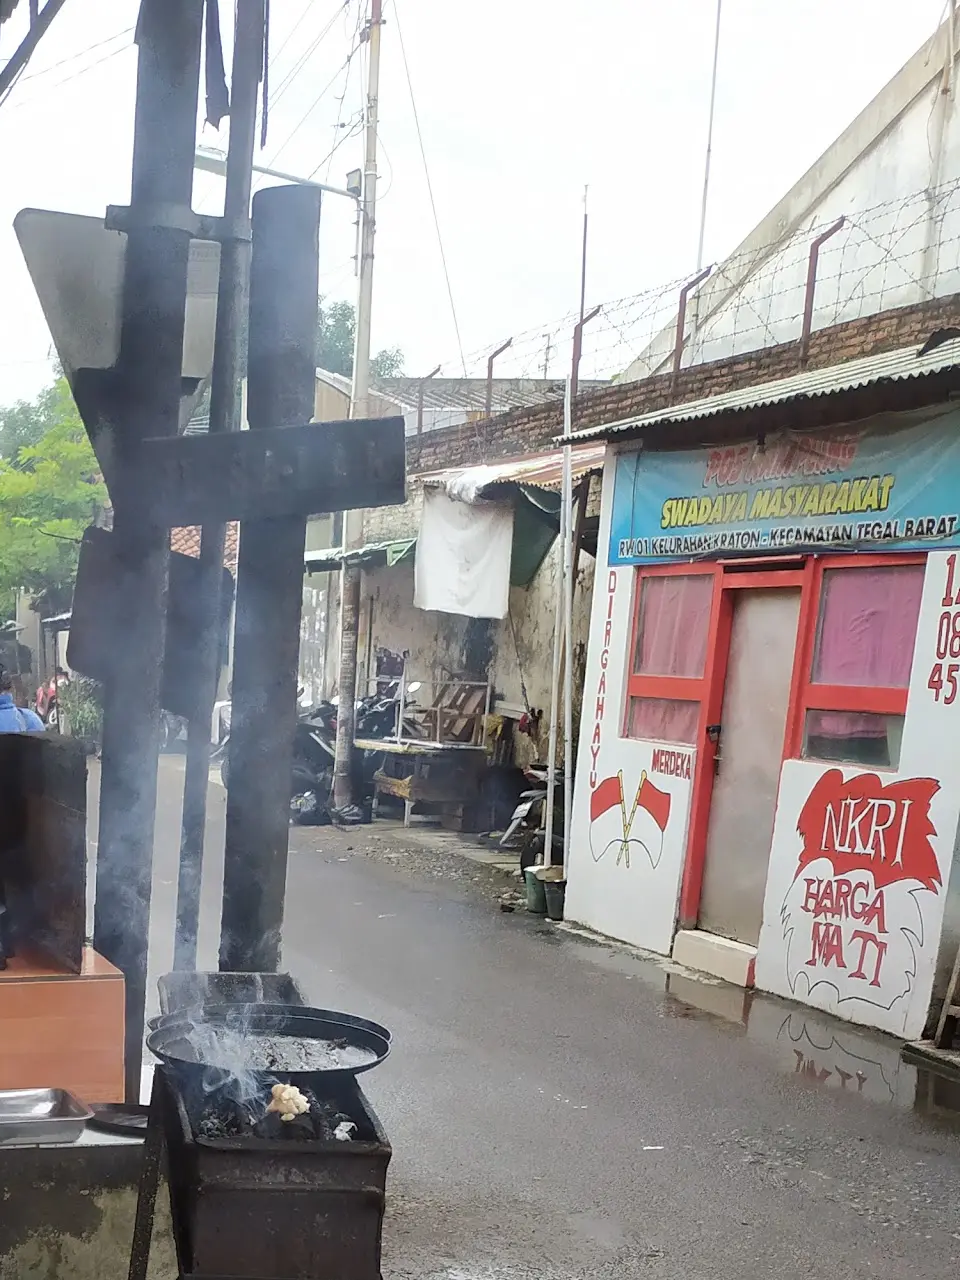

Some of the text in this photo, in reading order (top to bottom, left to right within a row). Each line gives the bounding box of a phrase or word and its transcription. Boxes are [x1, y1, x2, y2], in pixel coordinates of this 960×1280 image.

[660, 474, 896, 530] SWADAYA MASYARAKAT
[651, 536, 712, 556] KELURAHAN
[713, 530, 761, 549] KRATON
[769, 524, 852, 547] KECAMATAN
[856, 520, 900, 540] TEGAL
[904, 515, 958, 539] BARAT
[942, 554, 960, 606] 1
[590, 570, 617, 788] DIRGAHAYU
[928, 663, 959, 704] 45
[652, 749, 691, 779] MERDEKA
[821, 795, 913, 870] NKRI
[800, 876, 889, 933] HARGA
